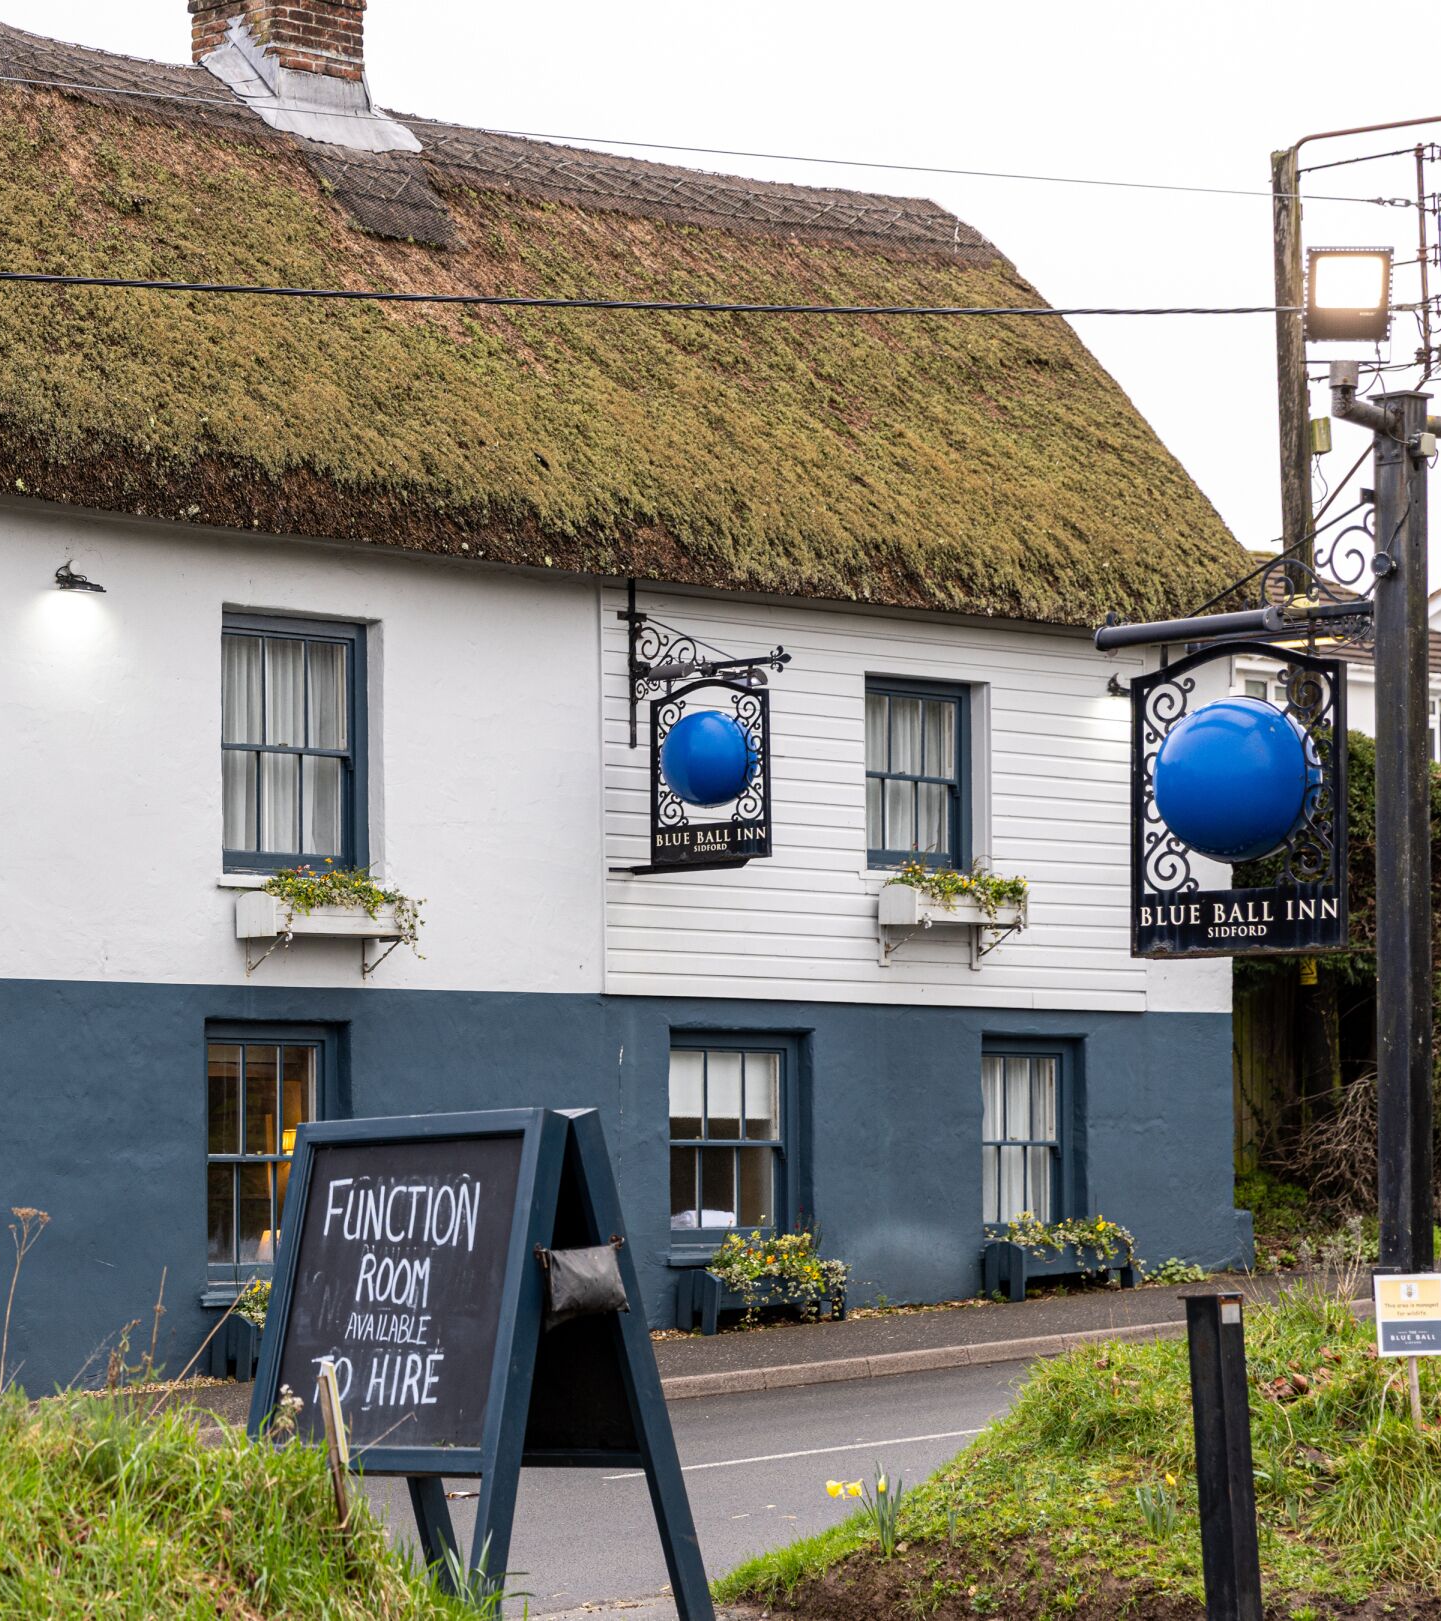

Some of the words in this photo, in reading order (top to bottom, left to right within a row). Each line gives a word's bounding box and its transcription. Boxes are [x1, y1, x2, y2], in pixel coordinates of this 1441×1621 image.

[656, 832, 690, 847] BLUE
[696, 829, 731, 844] BALL
[737, 827, 766, 840] INN
[694, 843, 727, 852] SIDFORD
[1140, 904, 1201, 927] BLUE
[1213, 901, 1274, 924] BALL
[1286, 898, 1338, 921] INN
[1207, 925, 1267, 938] SIDFORD
[324, 1178, 480, 1251] FUNCTION
[356, 1253, 430, 1308] ROOM
[345, 1312, 431, 1344] AVAILABLE
[312, 1355, 353, 1404] TO
[366, 1354, 444, 1406] HIRE
